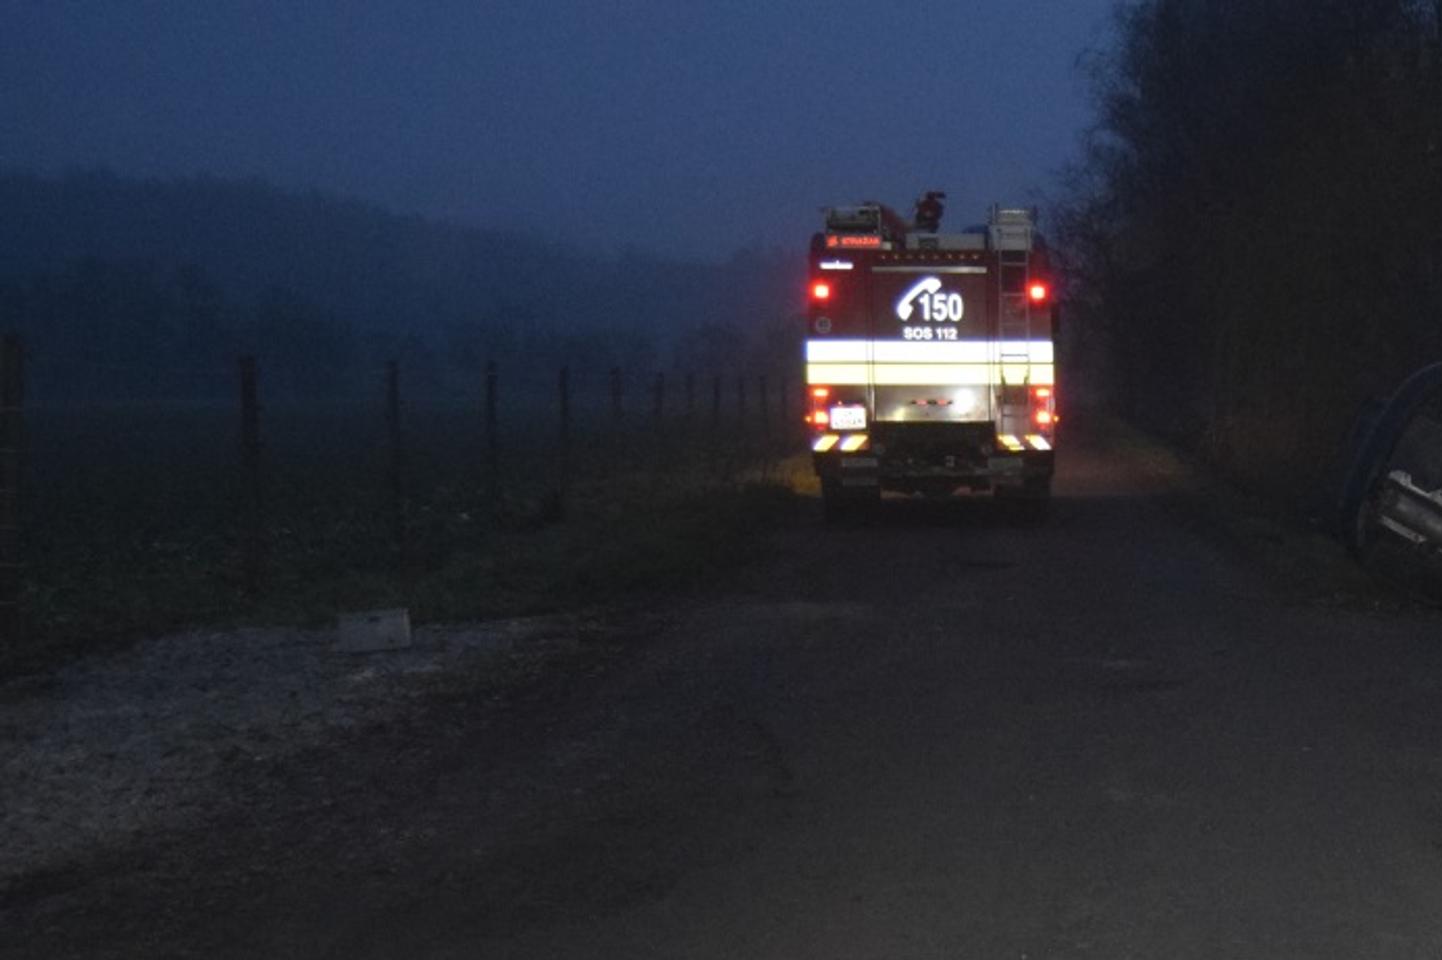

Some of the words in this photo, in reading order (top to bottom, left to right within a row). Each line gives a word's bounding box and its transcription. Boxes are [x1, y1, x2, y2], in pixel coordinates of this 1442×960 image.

[919, 293, 964, 321] 150
[903, 326, 933, 340] SOS
[936, 327, 958, 340] 112
